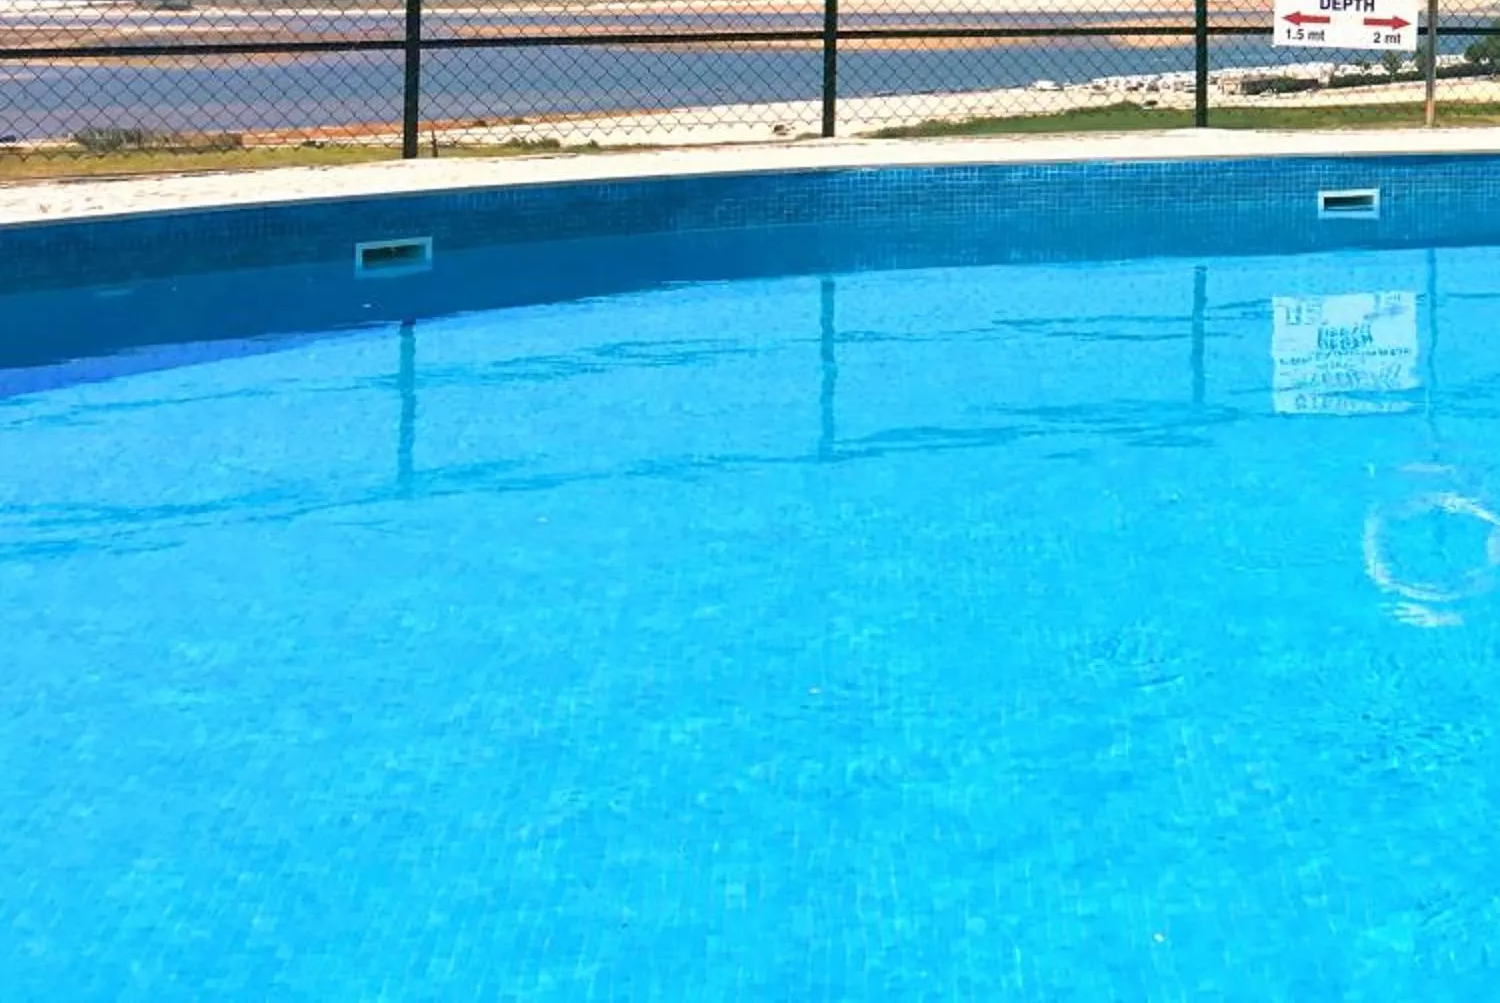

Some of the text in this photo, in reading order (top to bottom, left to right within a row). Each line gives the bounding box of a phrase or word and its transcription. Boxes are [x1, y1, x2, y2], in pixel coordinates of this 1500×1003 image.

[1286, 29, 1325, 42] 1.5 mt
[1373, 32, 1402, 44] 2 mt
